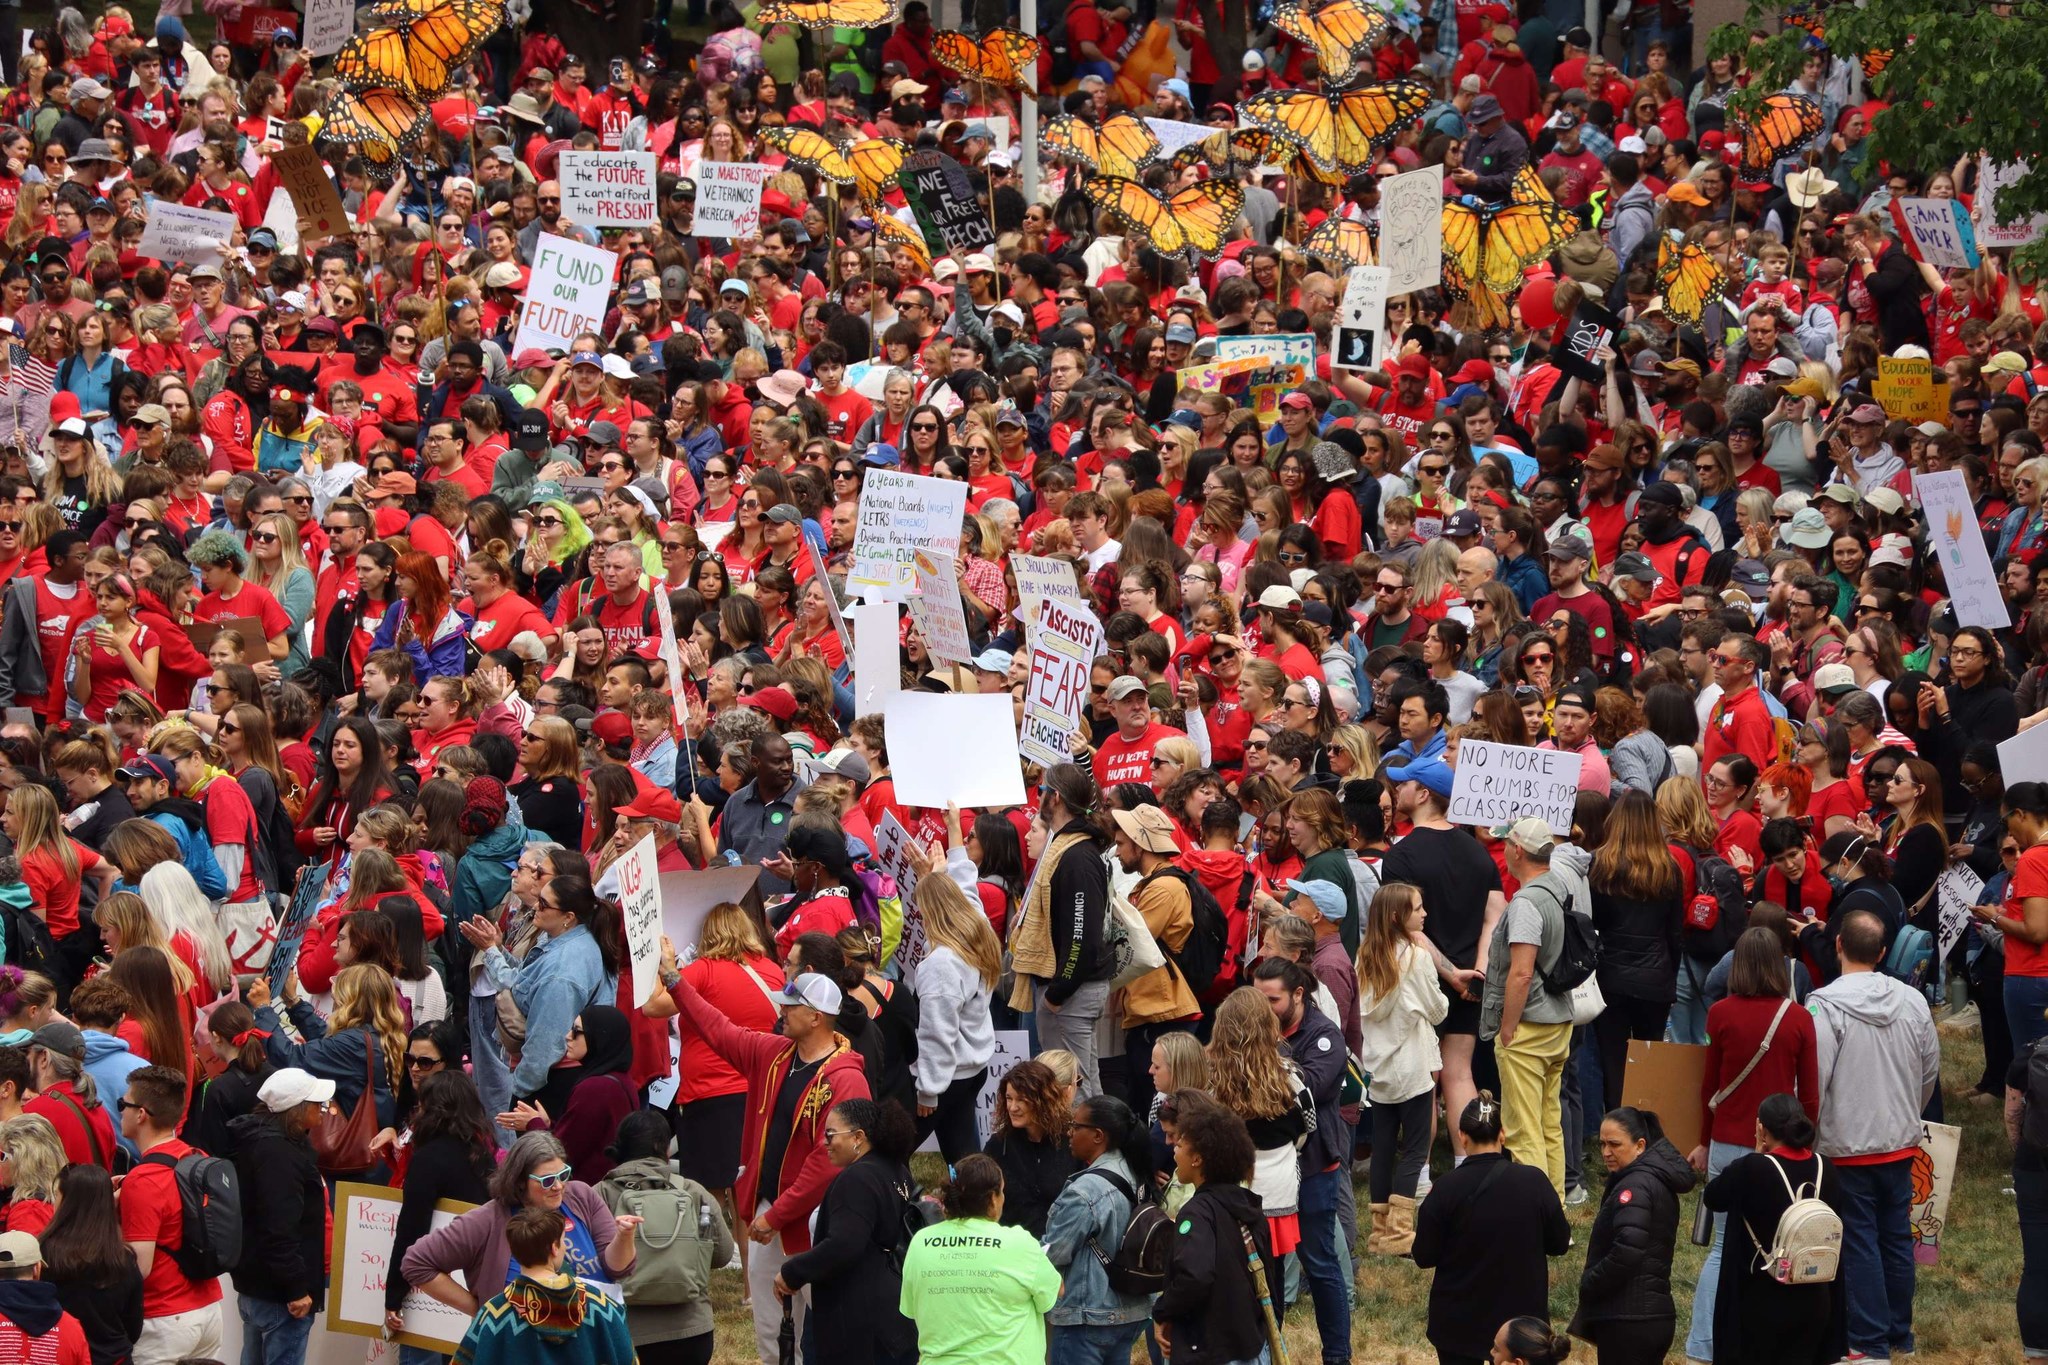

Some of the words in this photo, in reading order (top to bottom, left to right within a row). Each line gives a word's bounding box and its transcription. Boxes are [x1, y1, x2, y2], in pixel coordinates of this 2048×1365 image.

[253, 16, 281, 31] KIDS
[602, 110, 630, 133] KID
[565, 155, 578, 167] I
[583, 153, 638, 169] educate
[575, 168, 593, 182] the
[701, 166, 714, 179] LOS
[717, 165, 762, 185] MAESTROS
[296, 184, 321, 200] NOT
[568, 187, 580, 198] I
[584, 186, 612, 198] can't
[614, 188, 651, 200] afford
[704, 184, 755, 204] VETERANOS
[303, 199, 329, 216] ICE
[576, 203, 594, 215] the
[597, 200, 655, 219] PRESENT
[698, 206, 735, 221] MERECEN
[940, 193, 981, 220] FREE
[1905, 204, 1949, 224] GAME
[1914, 225, 1953, 249] OVER
[1996, 233, 2026, 241] THINGS
[540, 249, 604, 286] FUND
[553, 283, 579, 303] OUR
[1357, 296, 1376, 308] THIS
[524, 301, 598, 340] FUTURE
[1282, 341, 1292, 351] I
[1568, 320, 1600, 357] KIDS
[1881, 360, 1931, 375] EDUCATION
[1888, 387, 1915, 399] HOPE
[1884, 400, 1902, 412] NOT
[1910, 402, 1929, 412] OUR
[522, 424, 541, 434] NC-301
[867, 472, 875, 488] 6
[898, 495, 925, 514] Boards
[889, 530, 932, 548] Practitioner
[855, 544, 867, 558] EC
[868, 545, 894, 560] Growth
[872, 563, 893, 578] STAY
[899, 566, 912, 581] IF
[1012, 558, 1022, 572] I
[1025, 557, 1067, 574] SHOULDN'T
[1020, 580, 1034, 593] HAVE
[1044, 582, 1075, 597] MARRY
[1040, 600, 1094, 647] FASCISTS
[1028, 648, 1087, 722] FEAR
[1024, 714, 1071, 754] TEACHERS
[1107, 755, 1116, 766] IF
[1117, 754, 1124, 764] U
[1461, 746, 1488, 767] NO
[1501, 749, 1555, 775] MORE
[1469, 775, 1540, 799] CRUMBS
[1548, 783, 1577, 802] FOR
[1952, 863, 1979, 891] EVERY
[1938, 872, 1967, 913] ofession
[1073, 891, 1085, 940] CONVERGE
[1068, 940, 1081, 962] JANE
[1062, 962, 1076, 980] DOE
[358, 1201, 399, 1236] Resp
[924, 1236, 1002, 1248] VOLUNTEER
[361, 1250, 385, 1268] So,
[932, 1268, 964, 1278] CORPORATE
[965, 1268, 976, 1277] TAX
[977, 1269, 1000, 1279] BREAKS
[960, 1286, 995, 1295] DEMOCRACY
